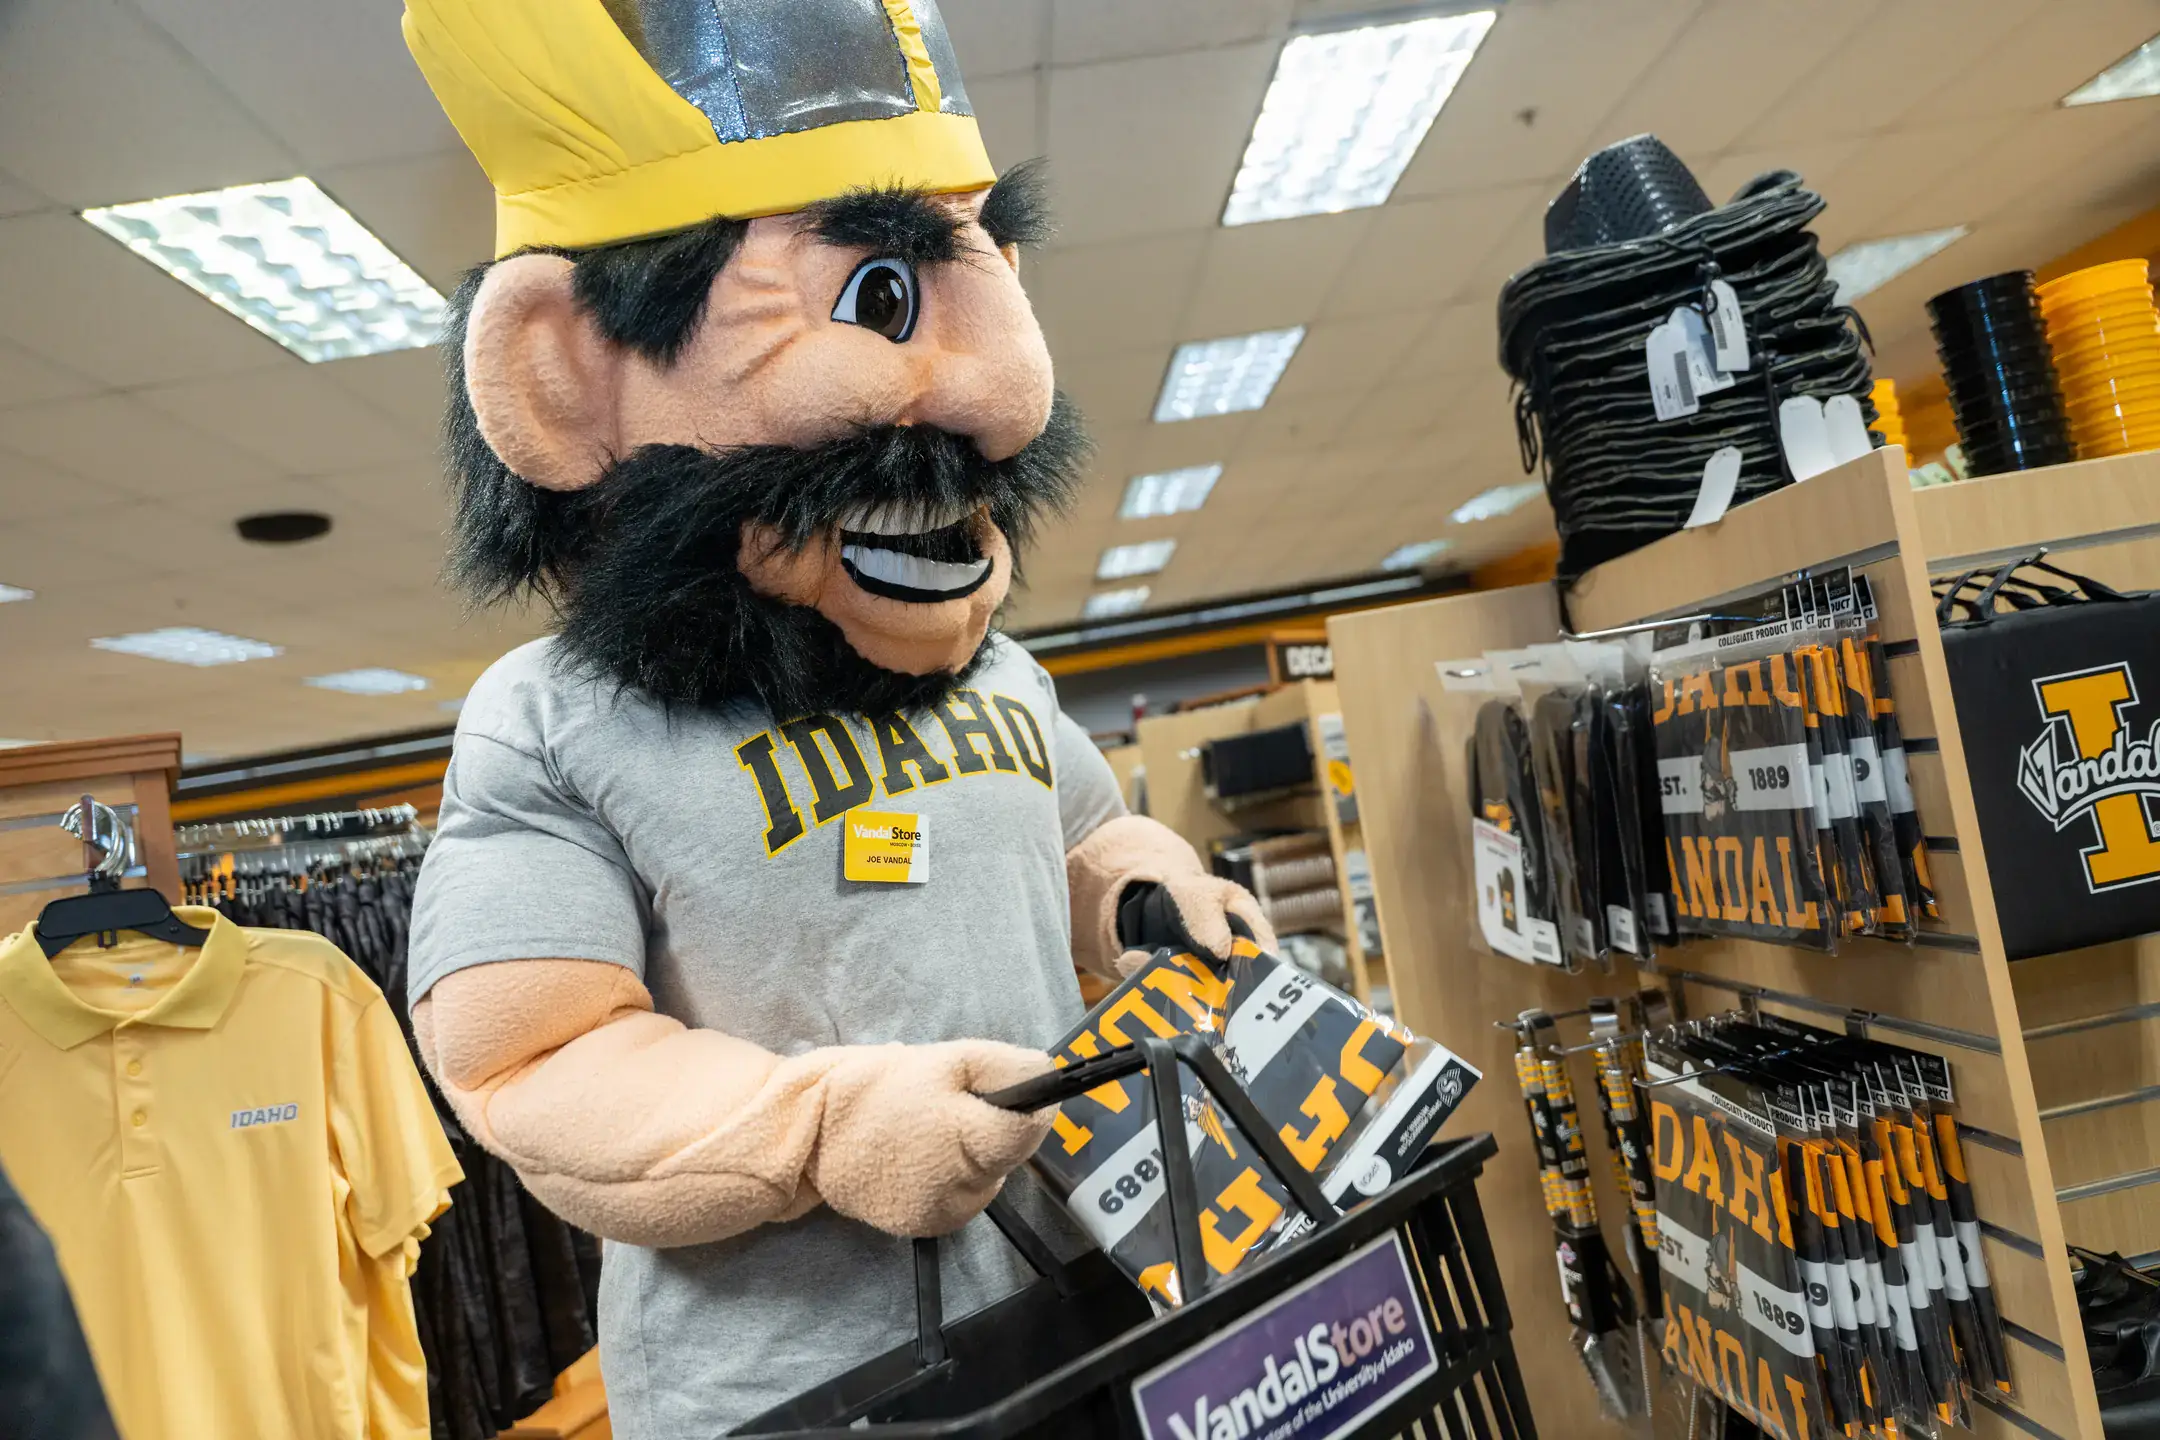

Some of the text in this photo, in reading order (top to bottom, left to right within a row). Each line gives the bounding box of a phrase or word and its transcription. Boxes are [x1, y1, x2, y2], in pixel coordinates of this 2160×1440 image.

[1717, 632, 1754, 647] COLLEGIATE
[1755, 623, 1788, 639] PRODUCT
[732, 687, 1053, 860] IDAHO
[1748, 764, 1790, 791] 1889
[866, 855, 913, 865] JOE VANDAL
[231, 1103, 298, 1128] IDAHO
[1711, 1093, 1774, 1135] COLLEGIATE PRODUCT
[1752, 1289, 1806, 1336] 1889
[1167, 1297, 1406, 1440] VandalStore
[1304, 1398, 1325, 1423] the
[1321, 1361, 1379, 1412] University
[1382, 1336, 1416, 1370] Idaho
